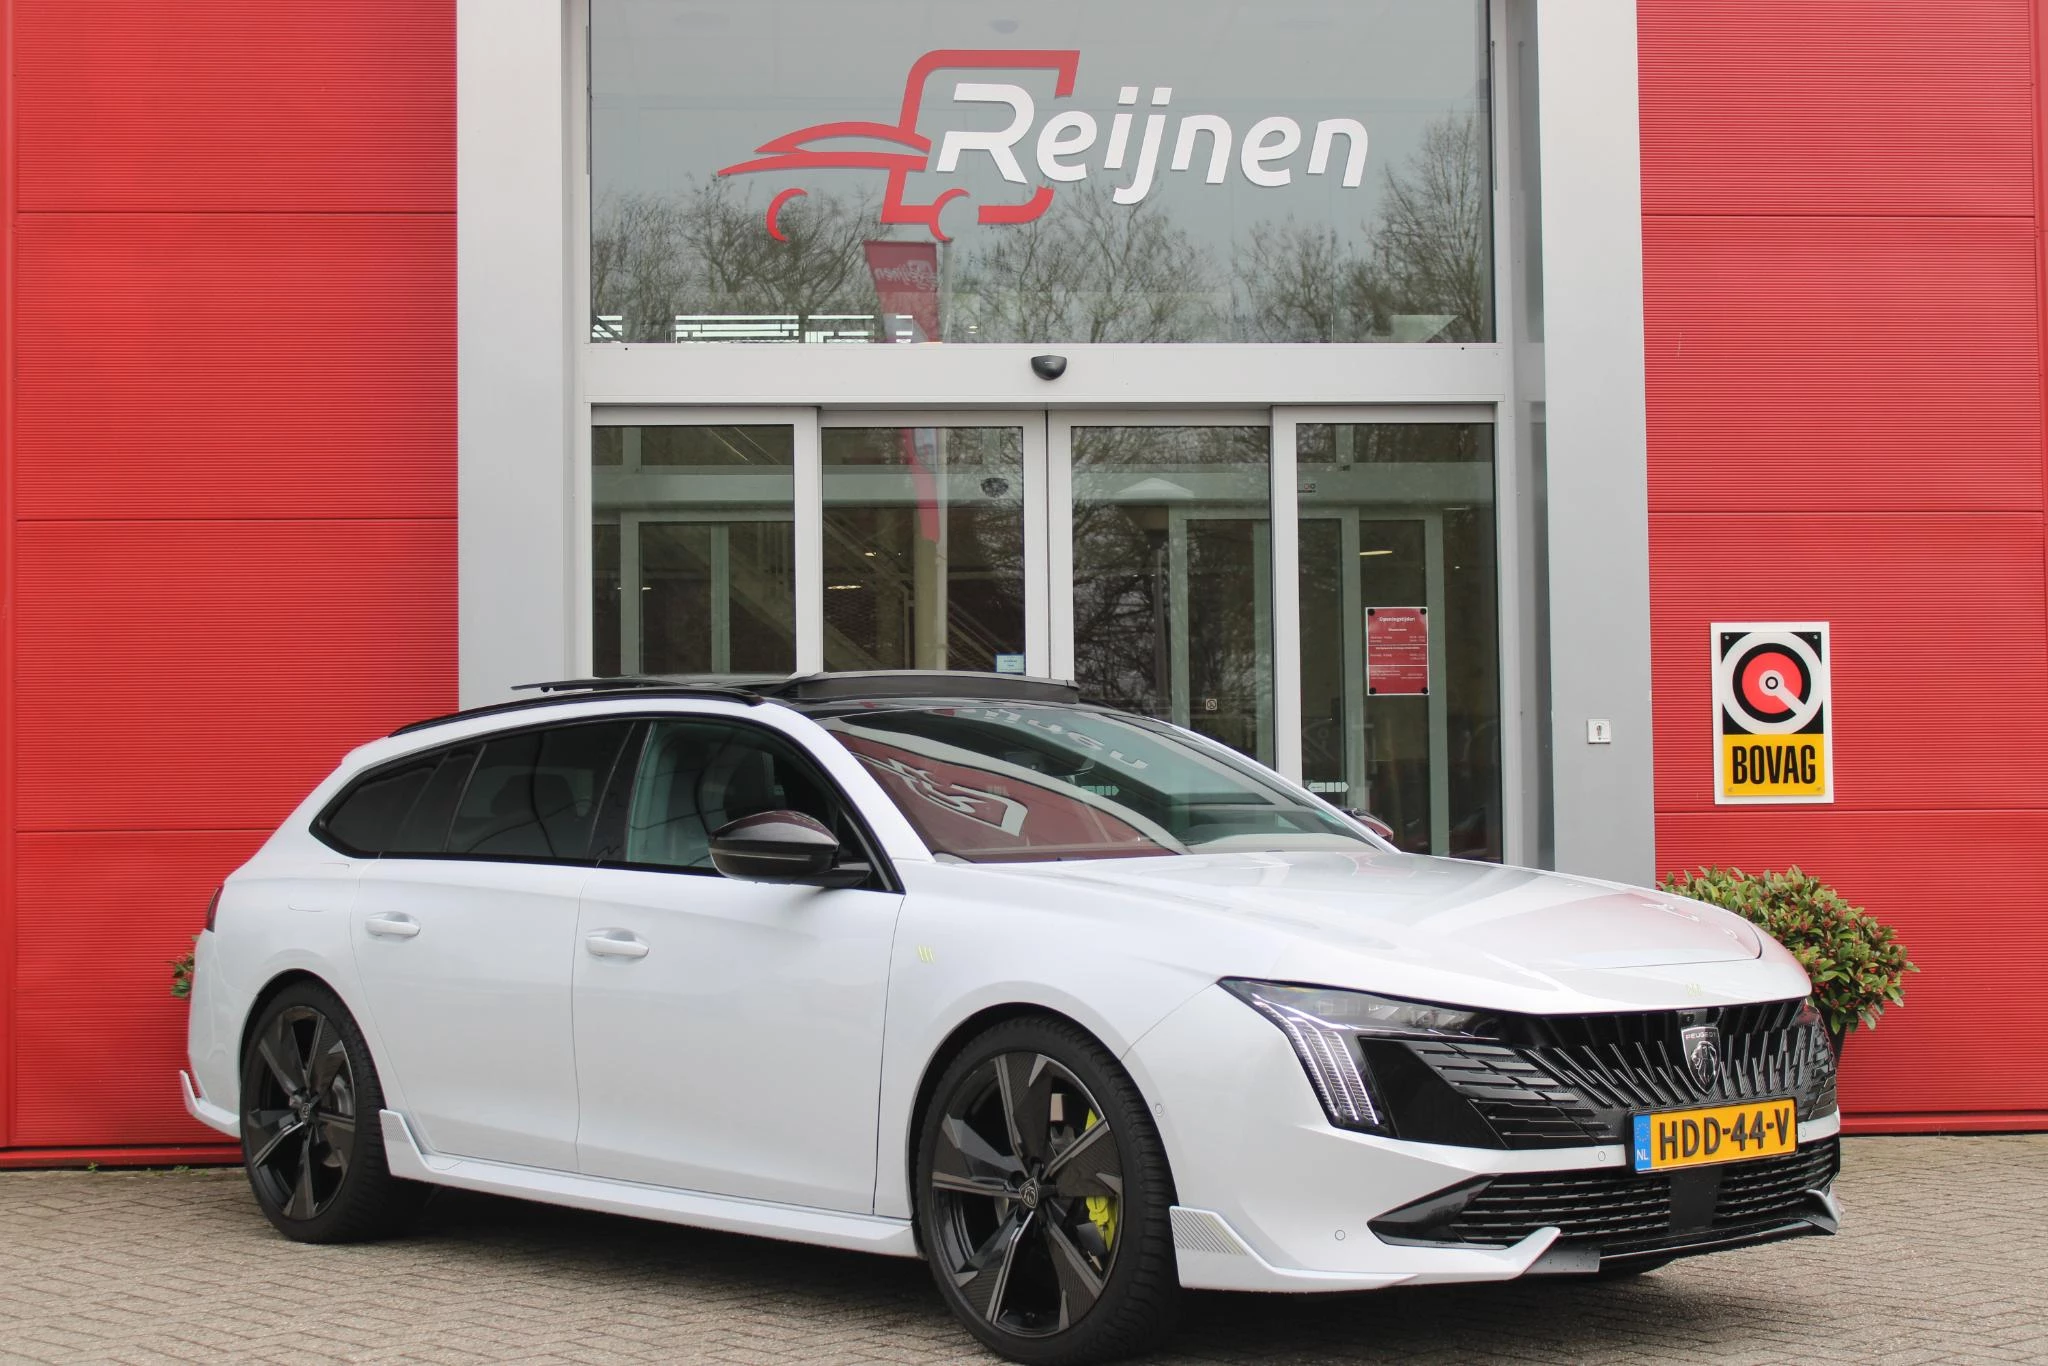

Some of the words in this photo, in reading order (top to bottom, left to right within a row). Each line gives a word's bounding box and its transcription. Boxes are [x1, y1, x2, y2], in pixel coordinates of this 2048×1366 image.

[936, 83, 1370, 206] Reijnen
[1732, 744, 1816, 785] BOVAG
[1685, 1031, 1716, 1040] PEUGEOT
[1636, 1148, 1649, 1161] NL
[1659, 1108, 1790, 1161] HDD-44-V
